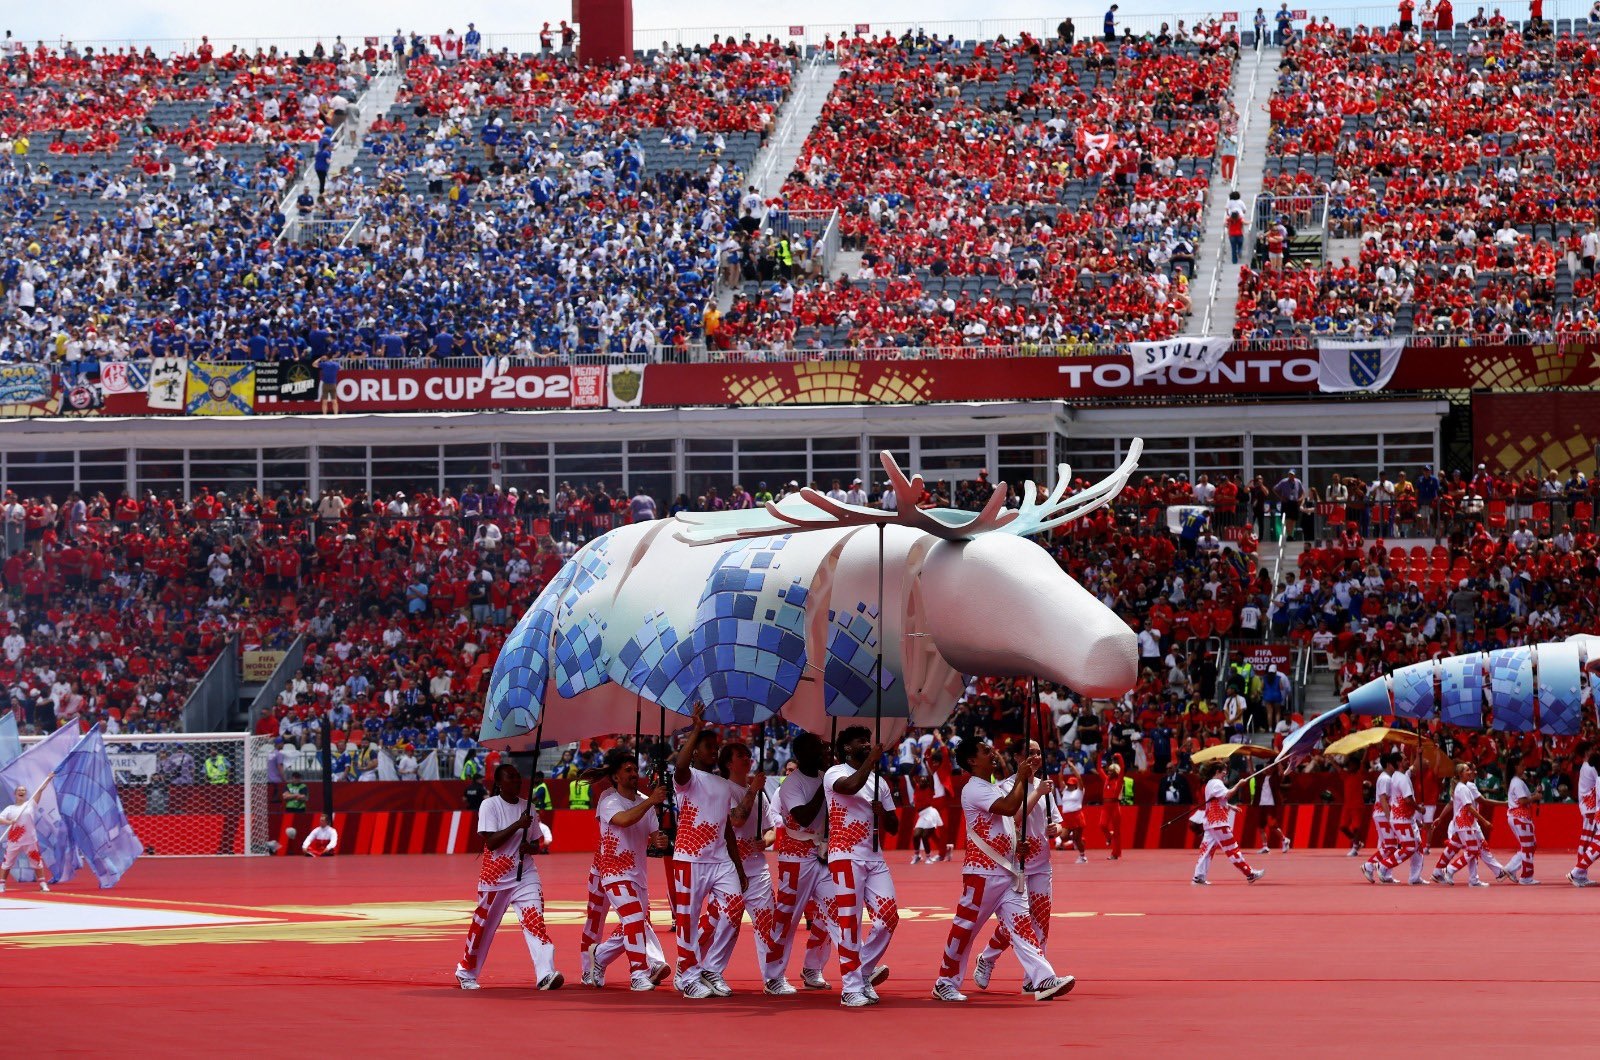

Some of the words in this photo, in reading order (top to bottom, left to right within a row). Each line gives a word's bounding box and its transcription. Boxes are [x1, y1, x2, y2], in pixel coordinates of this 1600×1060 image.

[320, 377, 419, 402] ORLD
[424, 376, 486, 400] CUP
[491, 374, 573, 399] 202
[594, 515, 609, 526] 115
[1320, 504, 1334, 514] 117
[1270, 656, 1287, 664] CUP
[605, 880, 649, 974] FIFA
[673, 860, 700, 975] FIFA
[828, 859, 862, 977] FIFA
[939, 874, 987, 979] FIFA
